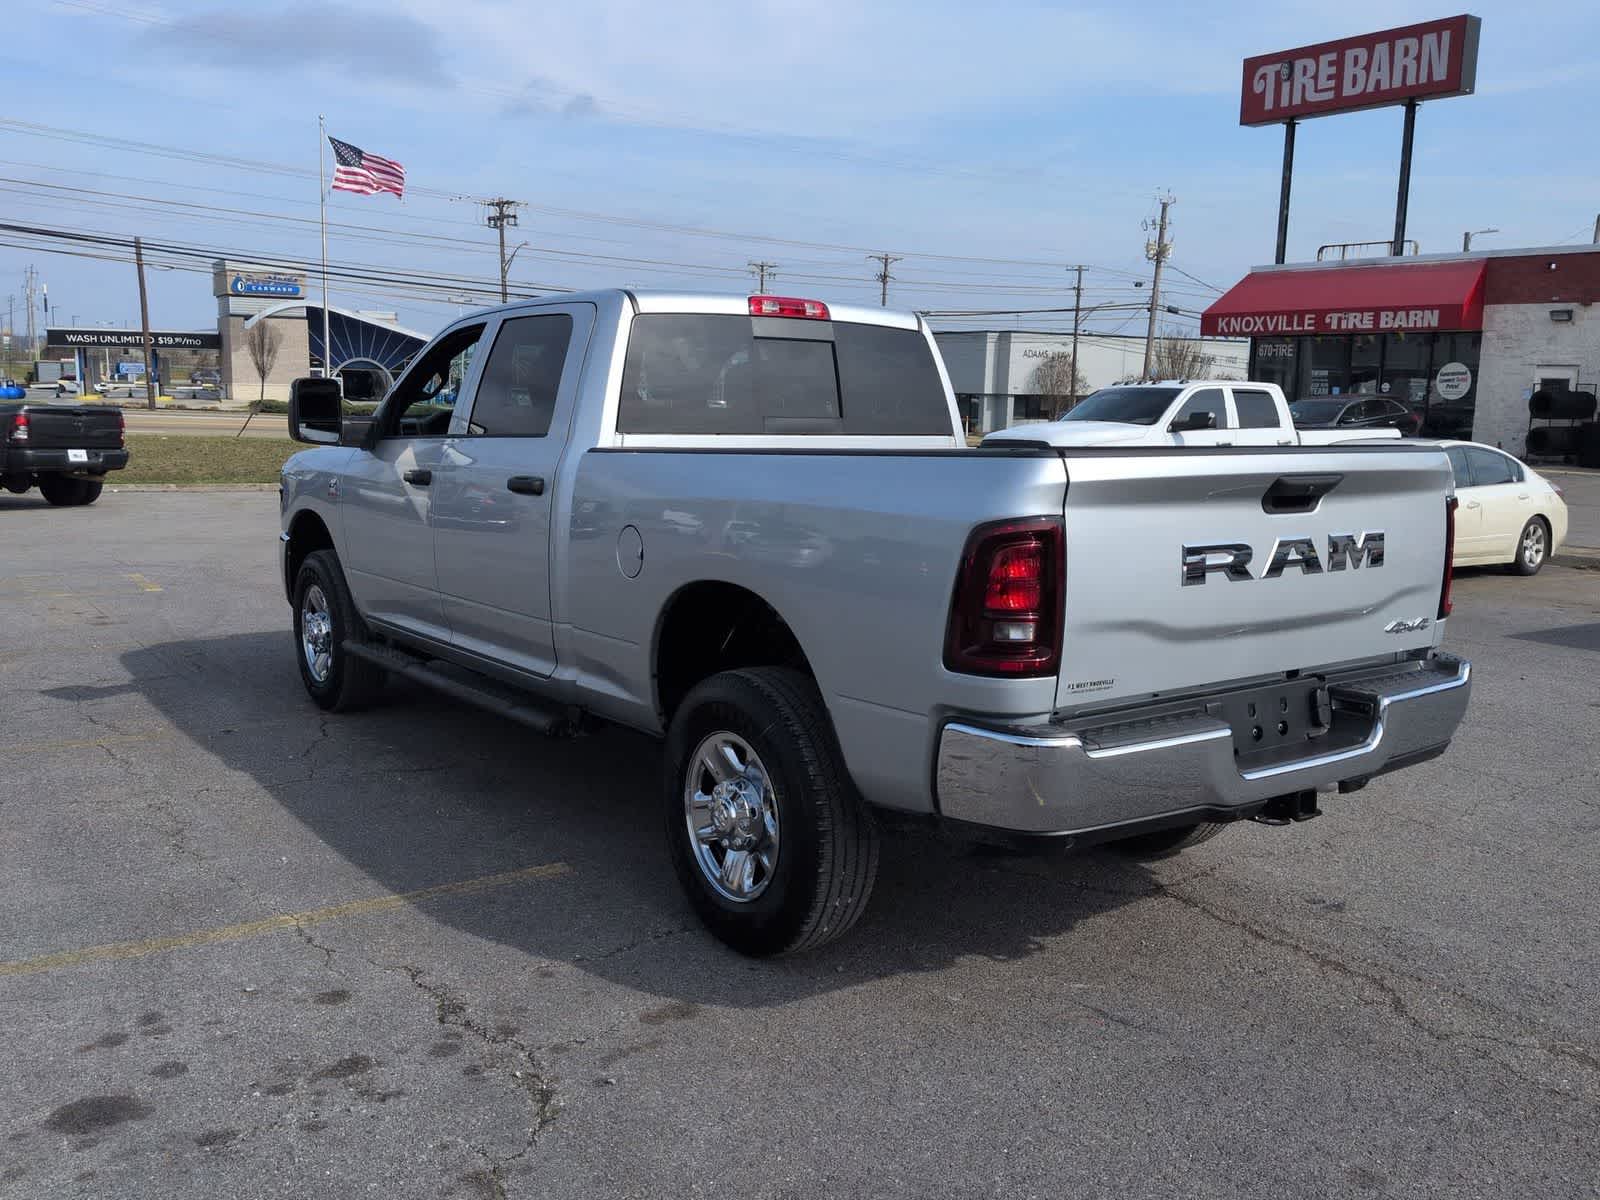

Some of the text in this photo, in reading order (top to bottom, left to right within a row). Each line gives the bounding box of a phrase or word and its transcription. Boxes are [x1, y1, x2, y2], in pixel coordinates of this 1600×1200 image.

[1342, 30, 1451, 97] BARN
[1217, 313, 1316, 333] KNOXVILLE
[1379, 310, 1440, 328] BARN
[65, 334, 98, 344] WASH
[1023, 349, 1049, 359] ADAMS
[1181, 529, 1385, 587] RAM
